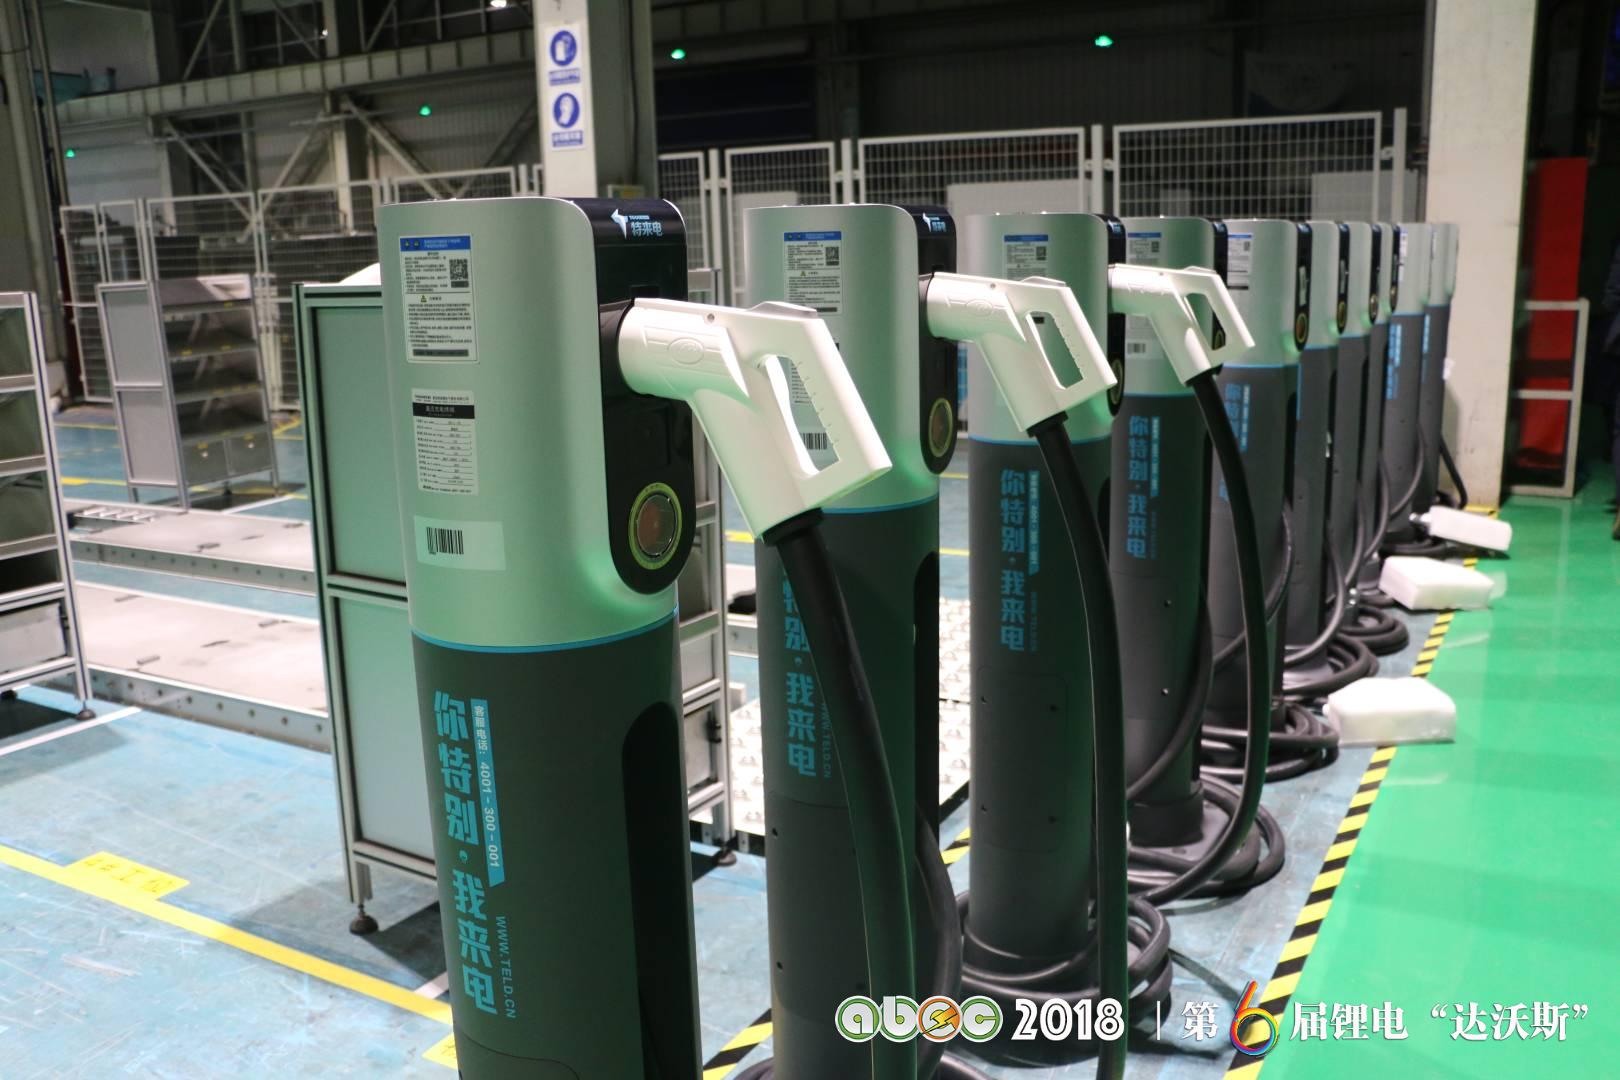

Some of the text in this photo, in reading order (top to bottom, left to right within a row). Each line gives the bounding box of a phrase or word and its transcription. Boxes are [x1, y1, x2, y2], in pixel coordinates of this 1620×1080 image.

[631, 221, 663, 237] 特来电
[434, 690, 497, 1015] 你特别·我来电
[495, 915, 517, 1019] WWW.TELD.CN
